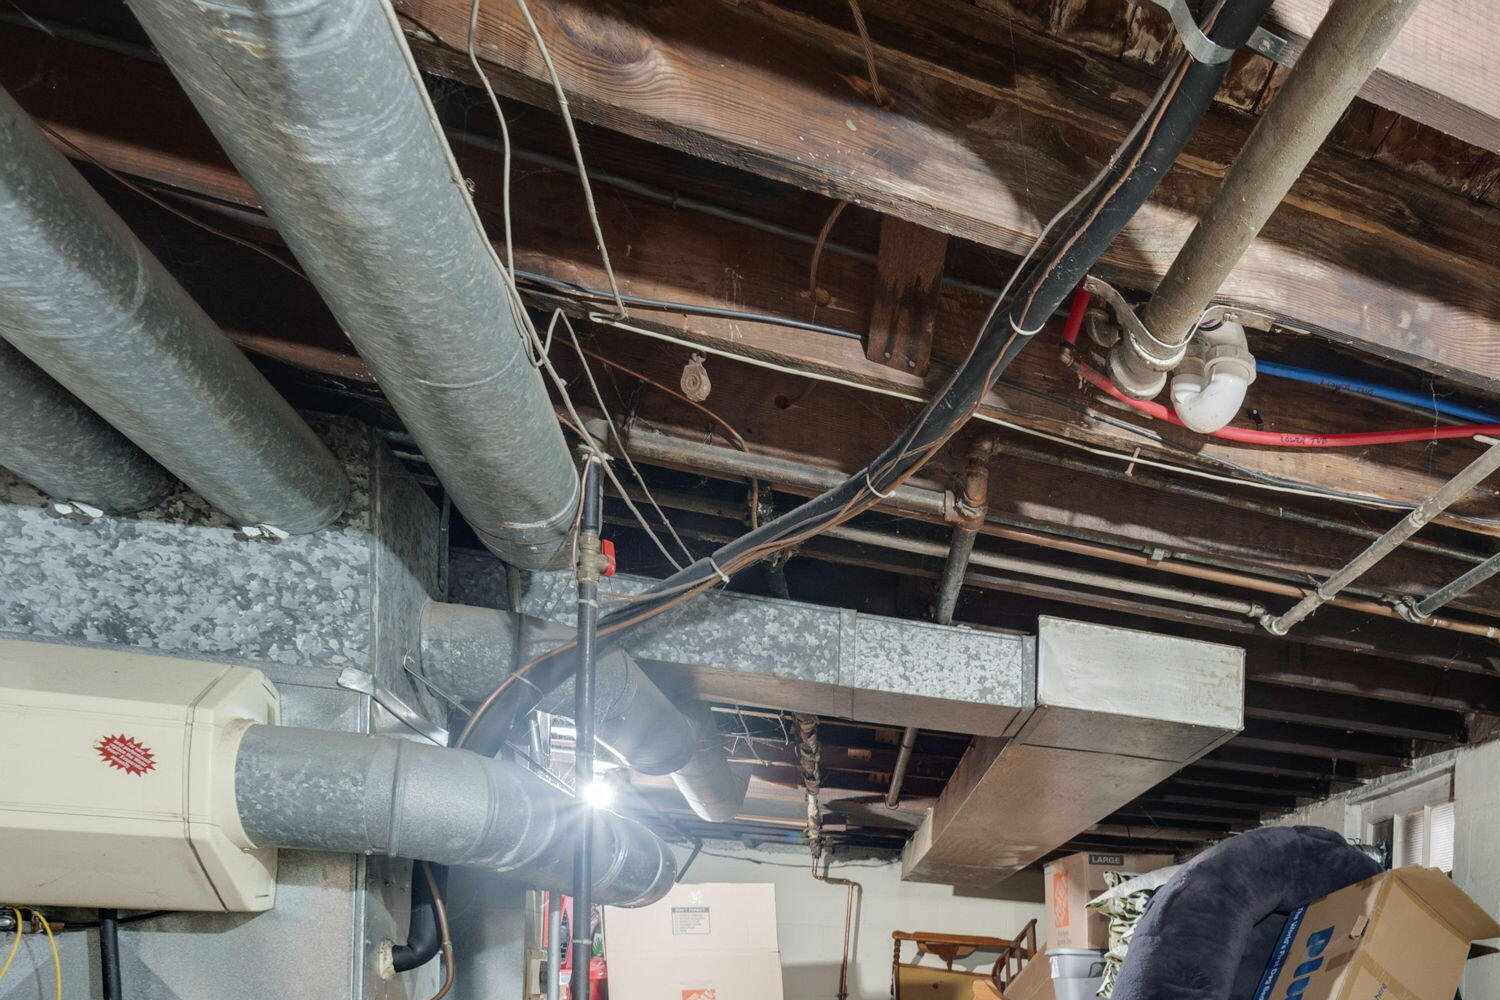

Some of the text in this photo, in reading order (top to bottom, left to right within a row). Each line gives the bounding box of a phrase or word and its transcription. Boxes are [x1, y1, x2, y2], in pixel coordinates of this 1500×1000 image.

[1310, 436, 1328, 445] TUB
[1092, 855, 1121, 864] LARGE
[1265, 968, 1278, 985] Dog
[1374, 983, 1388, 1000] here
